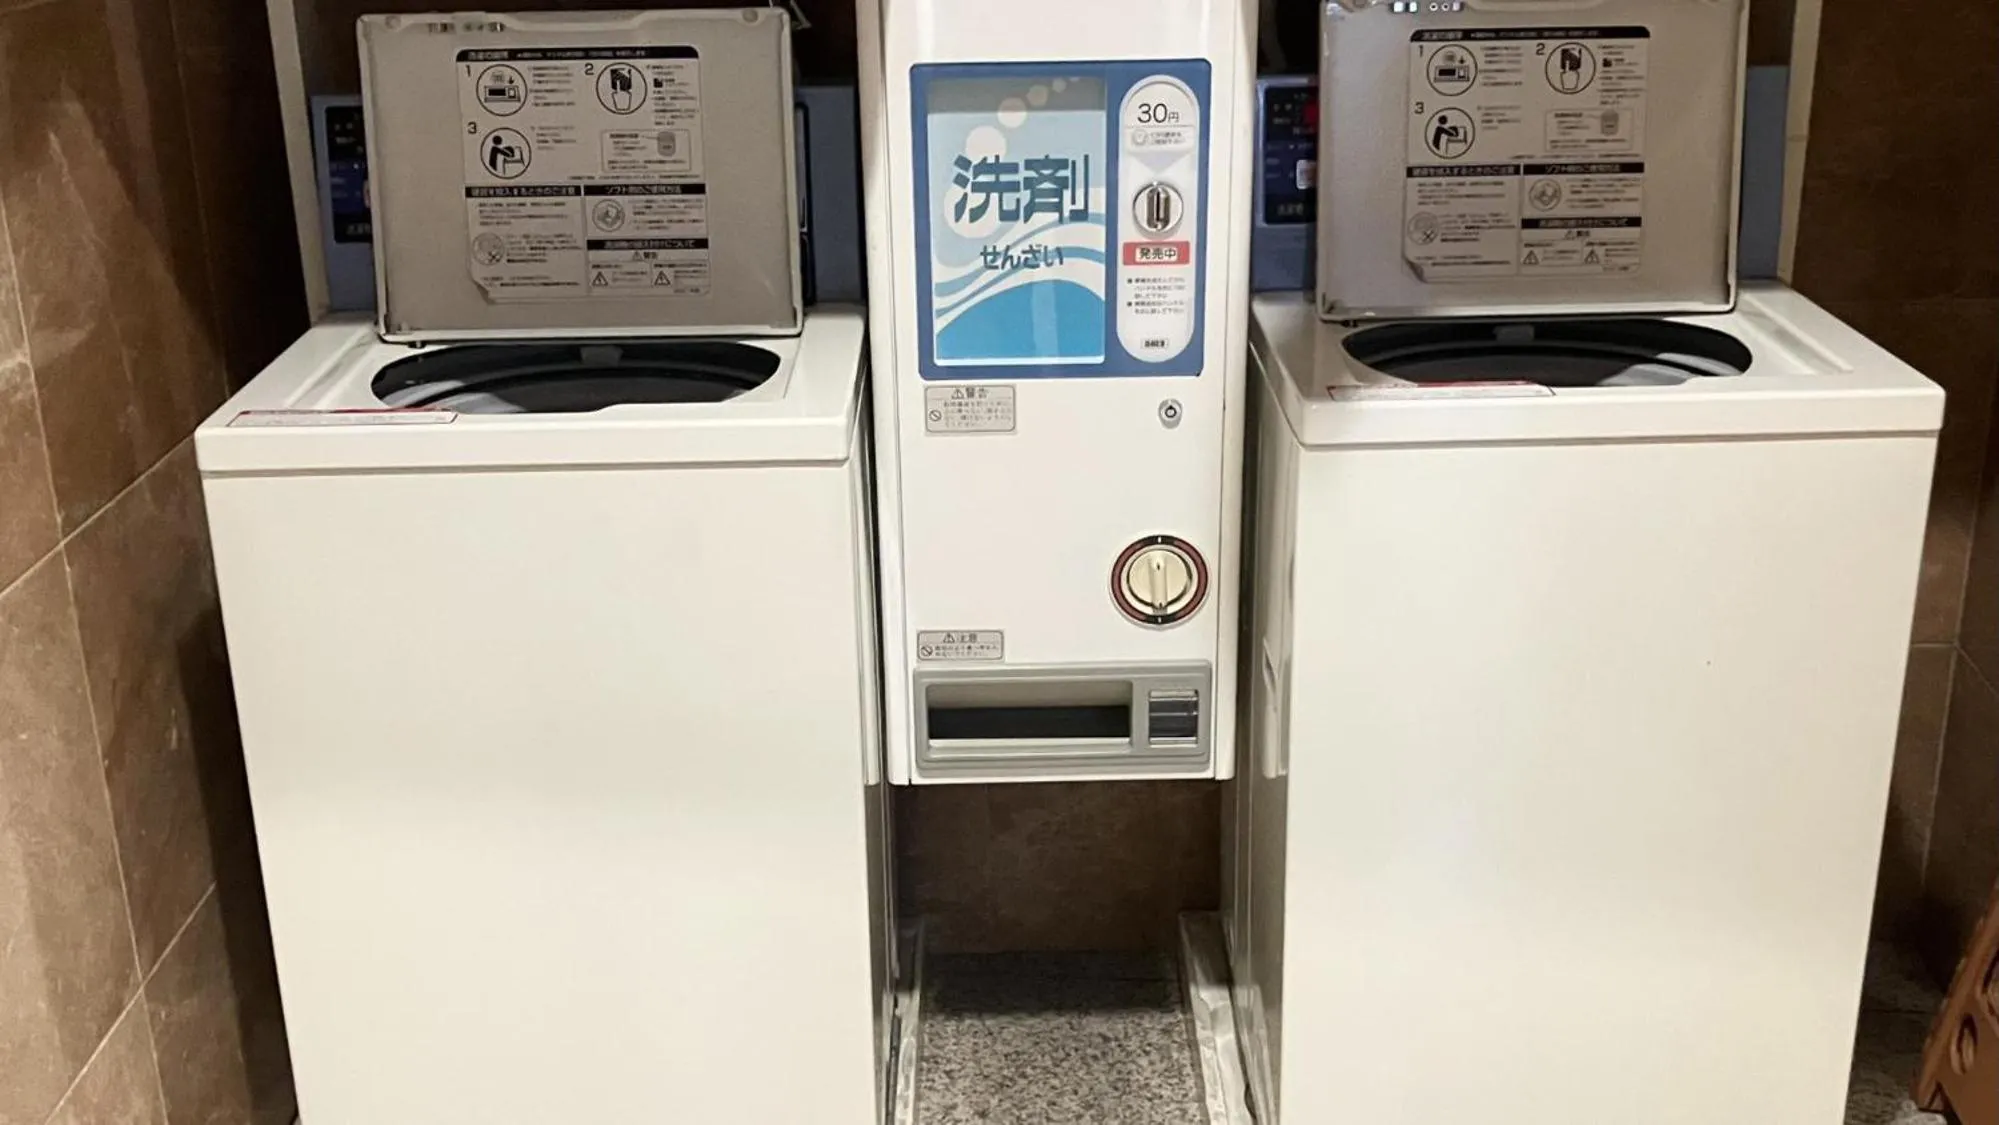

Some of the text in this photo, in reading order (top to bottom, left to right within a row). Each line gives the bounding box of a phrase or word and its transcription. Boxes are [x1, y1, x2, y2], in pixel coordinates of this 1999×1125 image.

[1418, 45, 1425, 57] 1
[1536, 43, 1546, 56] 2
[465, 64, 472, 77] 1
[585, 63, 594, 76] 2
[1137, 103, 1180, 124] 30円
[1414, 102, 1425, 114] 3
[467, 122, 477, 134] 3
[953, 154, 1090, 223] 洗剤
[980, 244, 1064, 270] せんざい
[1139, 247, 1177, 261] 発売中
